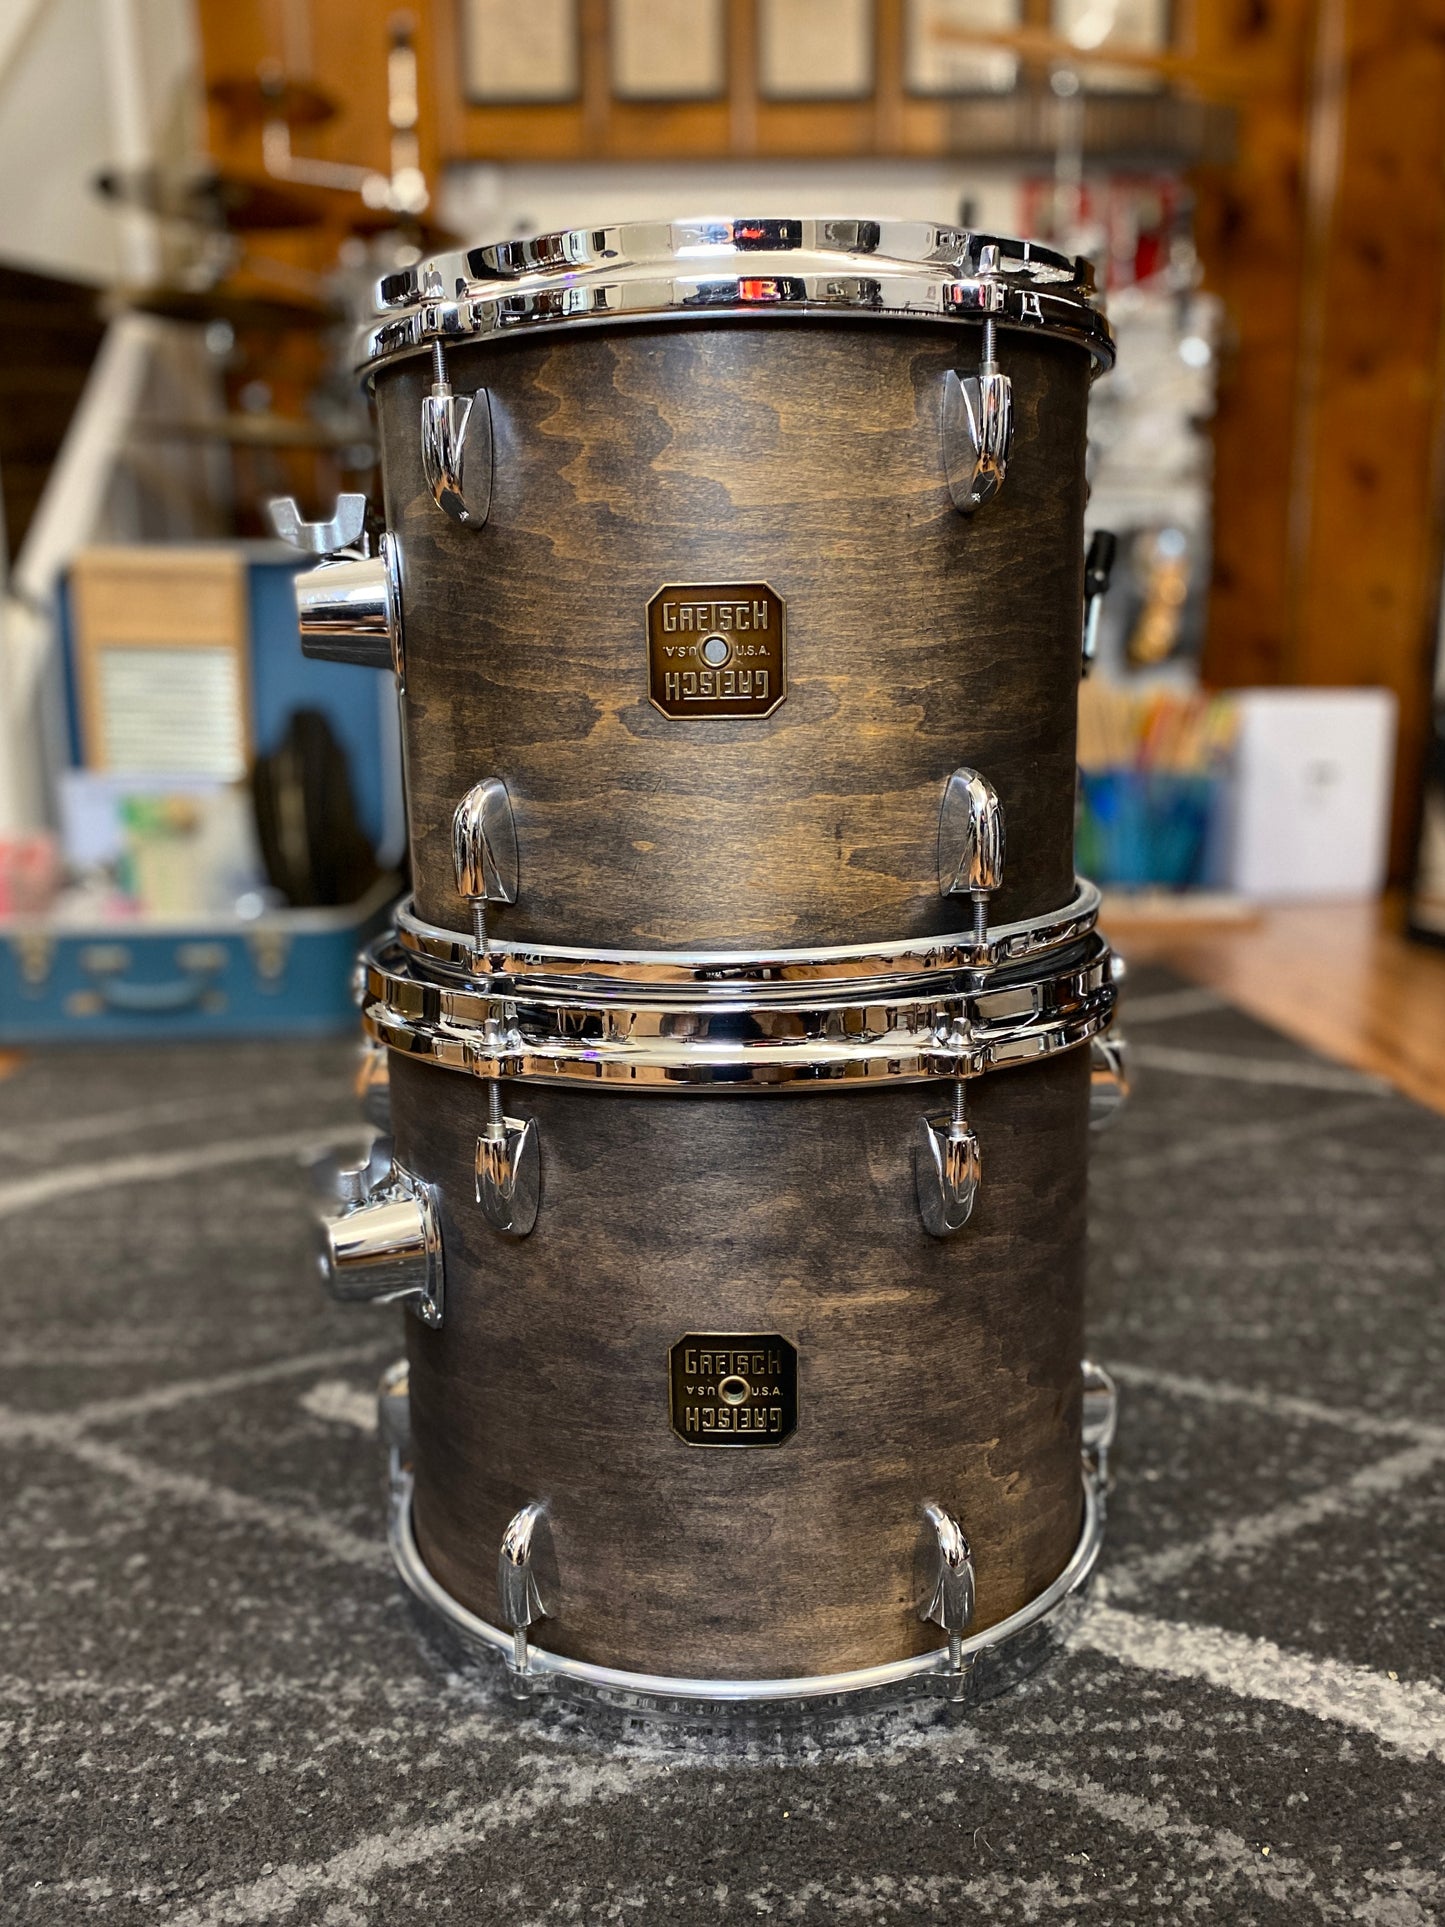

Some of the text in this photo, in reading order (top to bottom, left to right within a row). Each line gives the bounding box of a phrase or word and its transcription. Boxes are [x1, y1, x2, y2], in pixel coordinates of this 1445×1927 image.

[663, 601, 768, 632] GRETSCH
[735, 645, 771, 656] U.S.A.
[665, 670, 769, 700] GRETSCH
[685, 1350, 782, 1375] GRETSCH
[751, 1386, 784, 1396] U.S.A.
[685, 1407, 782, 1433] GRETSCH
